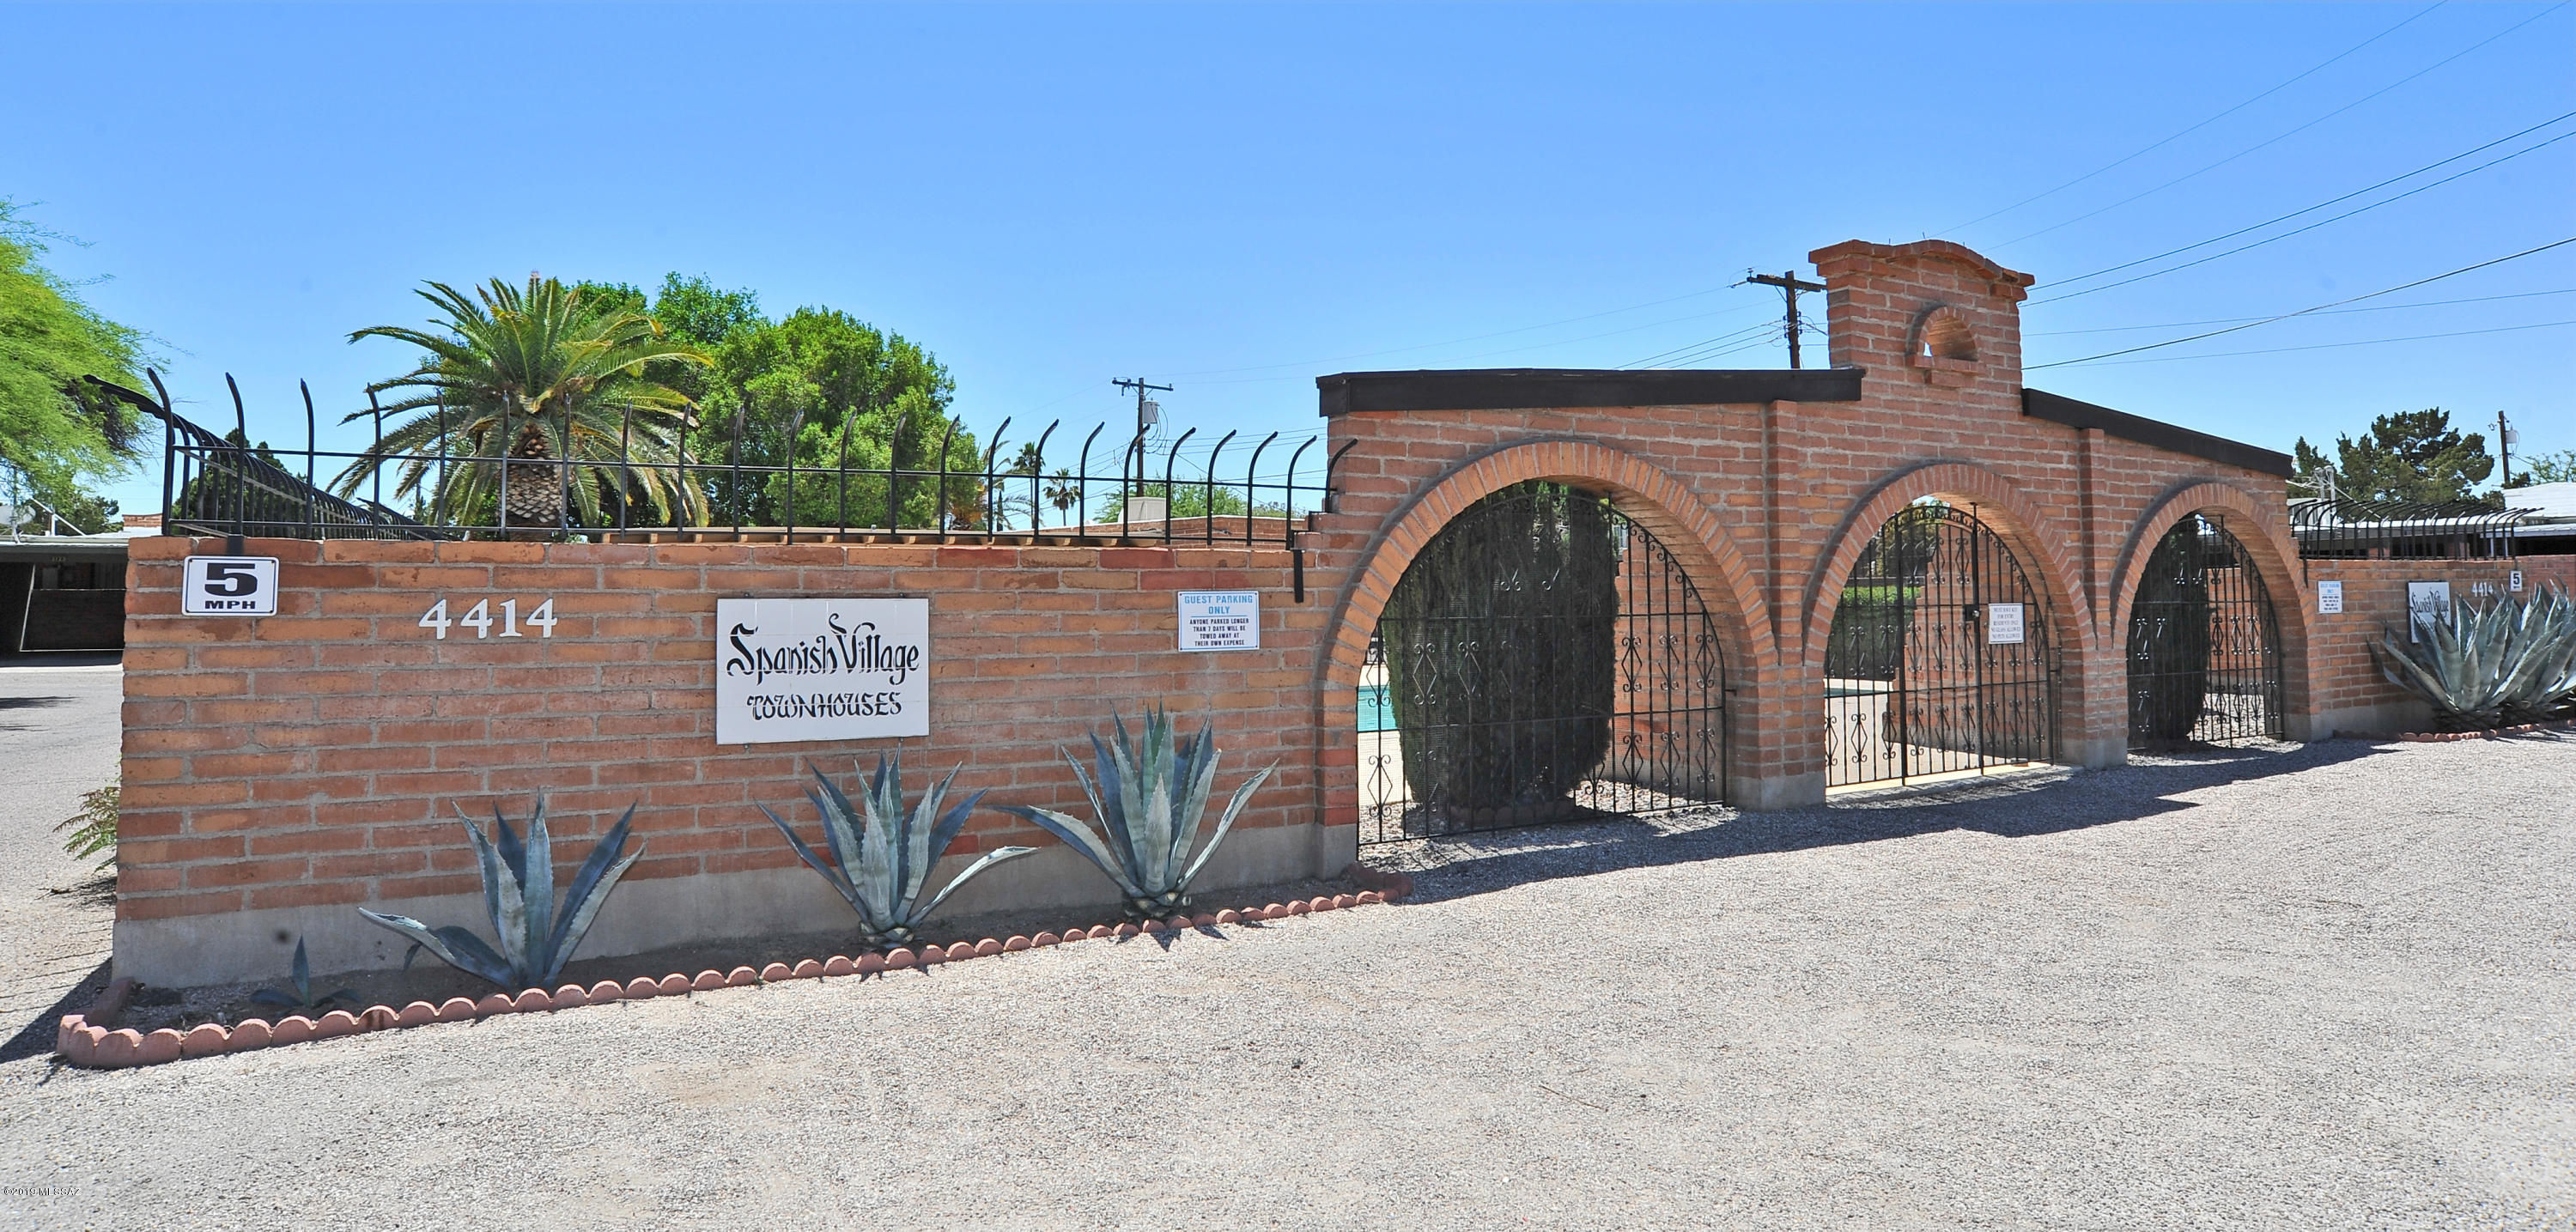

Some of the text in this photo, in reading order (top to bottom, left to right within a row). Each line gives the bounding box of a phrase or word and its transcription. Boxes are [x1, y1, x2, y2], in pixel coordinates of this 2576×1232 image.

[204, 562, 258, 597] 5
[2513, 573, 2520, 585] 5
[2471, 581, 2494, 597] 4414
[204, 600, 256, 610] MPH
[1184, 595, 1253, 604] GUEST PARKING
[1208, 606, 1230, 615] ONLY
[418, 598, 558, 640] 4414
[726, 613, 920, 686] Spanish Village
[746, 691, 902, 720] TOWNHOUSES
